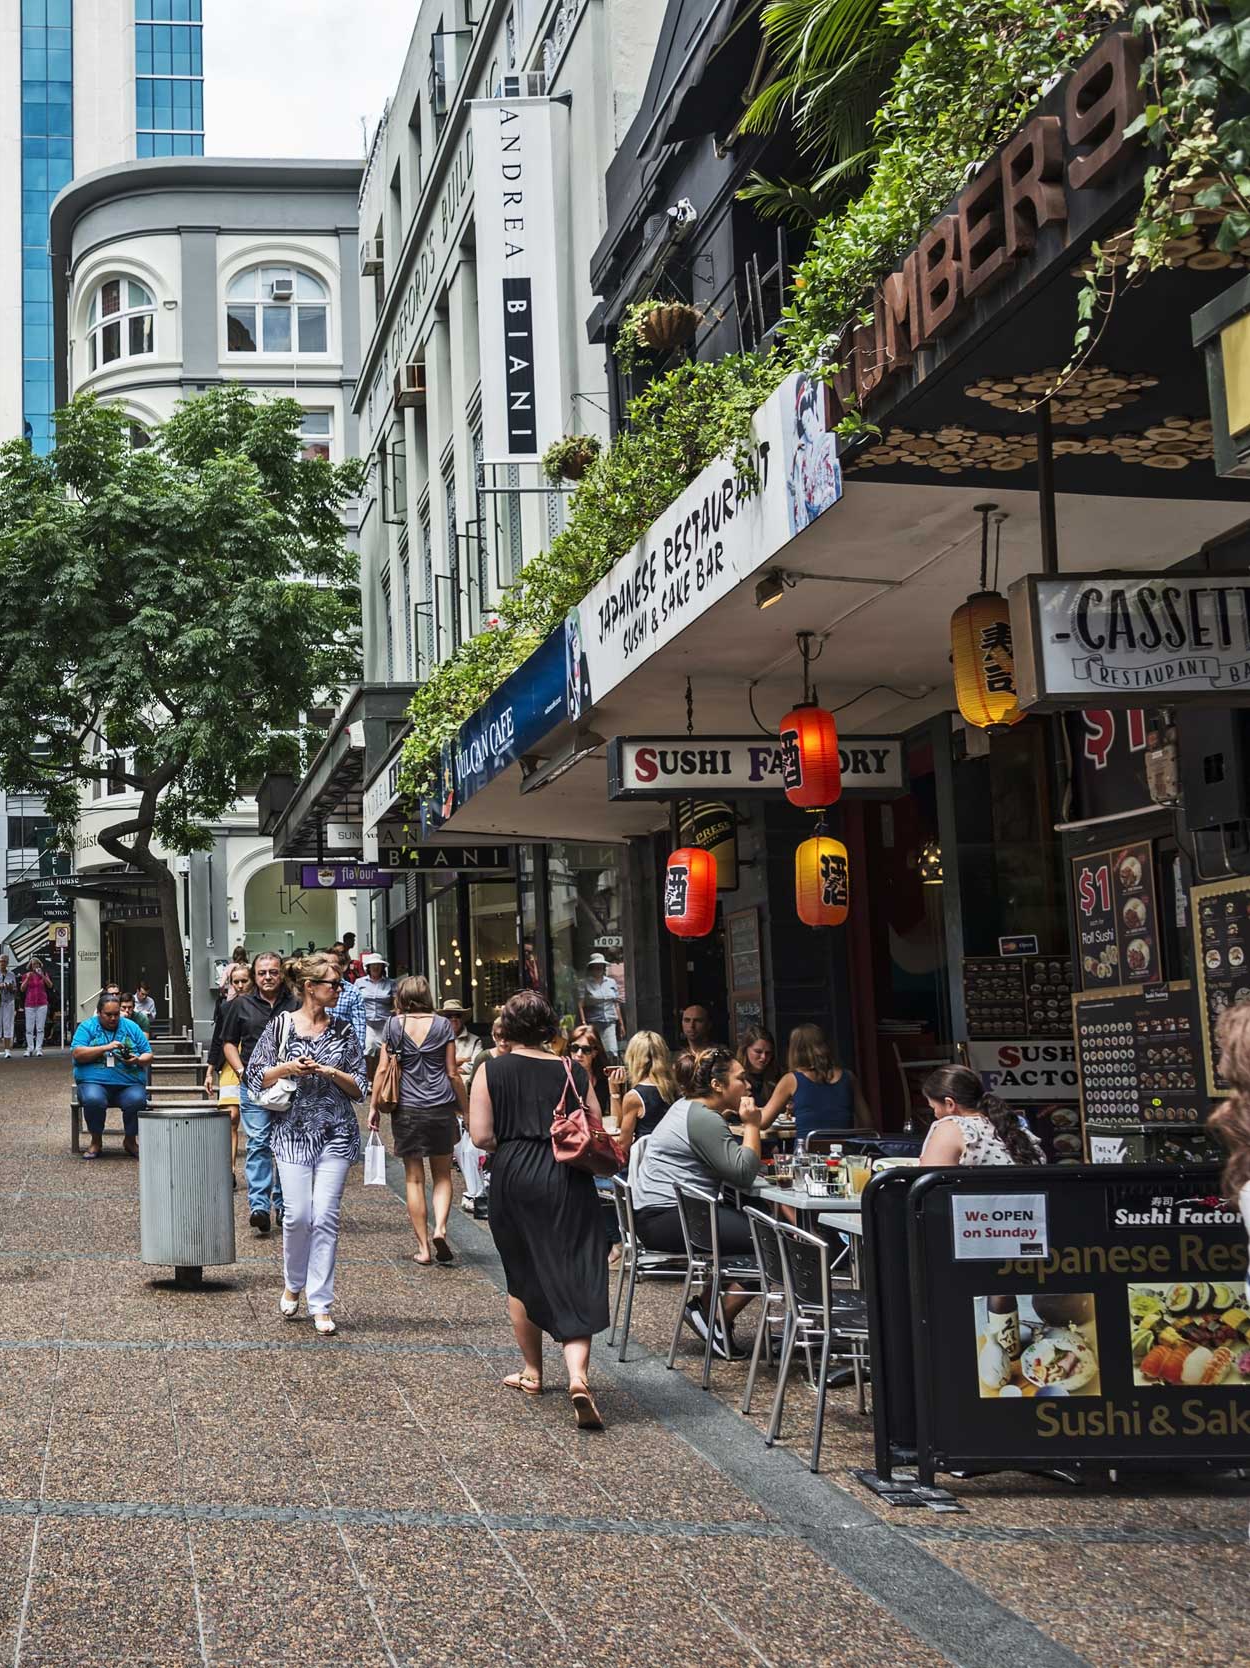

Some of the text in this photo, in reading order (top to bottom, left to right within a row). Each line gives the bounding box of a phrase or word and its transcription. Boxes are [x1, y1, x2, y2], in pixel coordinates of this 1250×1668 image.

[1066, 32, 1142, 190] 9
[499, 108, 532, 436] ANDREA BIANI
[392, 230, 435, 370] GIFFORD'S
[598, 442, 771, 645] JAPANESE RESTAURANT
[623, 541, 724, 659] SUSHI & SAKE BAR
[1100, 659, 1208, 686] RESTAURANT
[455, 705, 515, 785] VULCAN CAFE
[635, 746, 890, 782] SUSHI FAORY
[76, 832, 98, 851] Glaist
[31, 876, 79, 889] Norfolk House
[1079, 866, 1111, 916] $1
[1095, 928, 1114, 944] Sushi
[963, 1227, 1037, 1240] on Sunday
[964, 1210, 1034, 1222] We OPEN
[1115, 1207, 1244, 1225] Sushi Factor
[1036, 1401, 1142, 1438] Sushi
[1148, 1404, 1177, 1436] &
